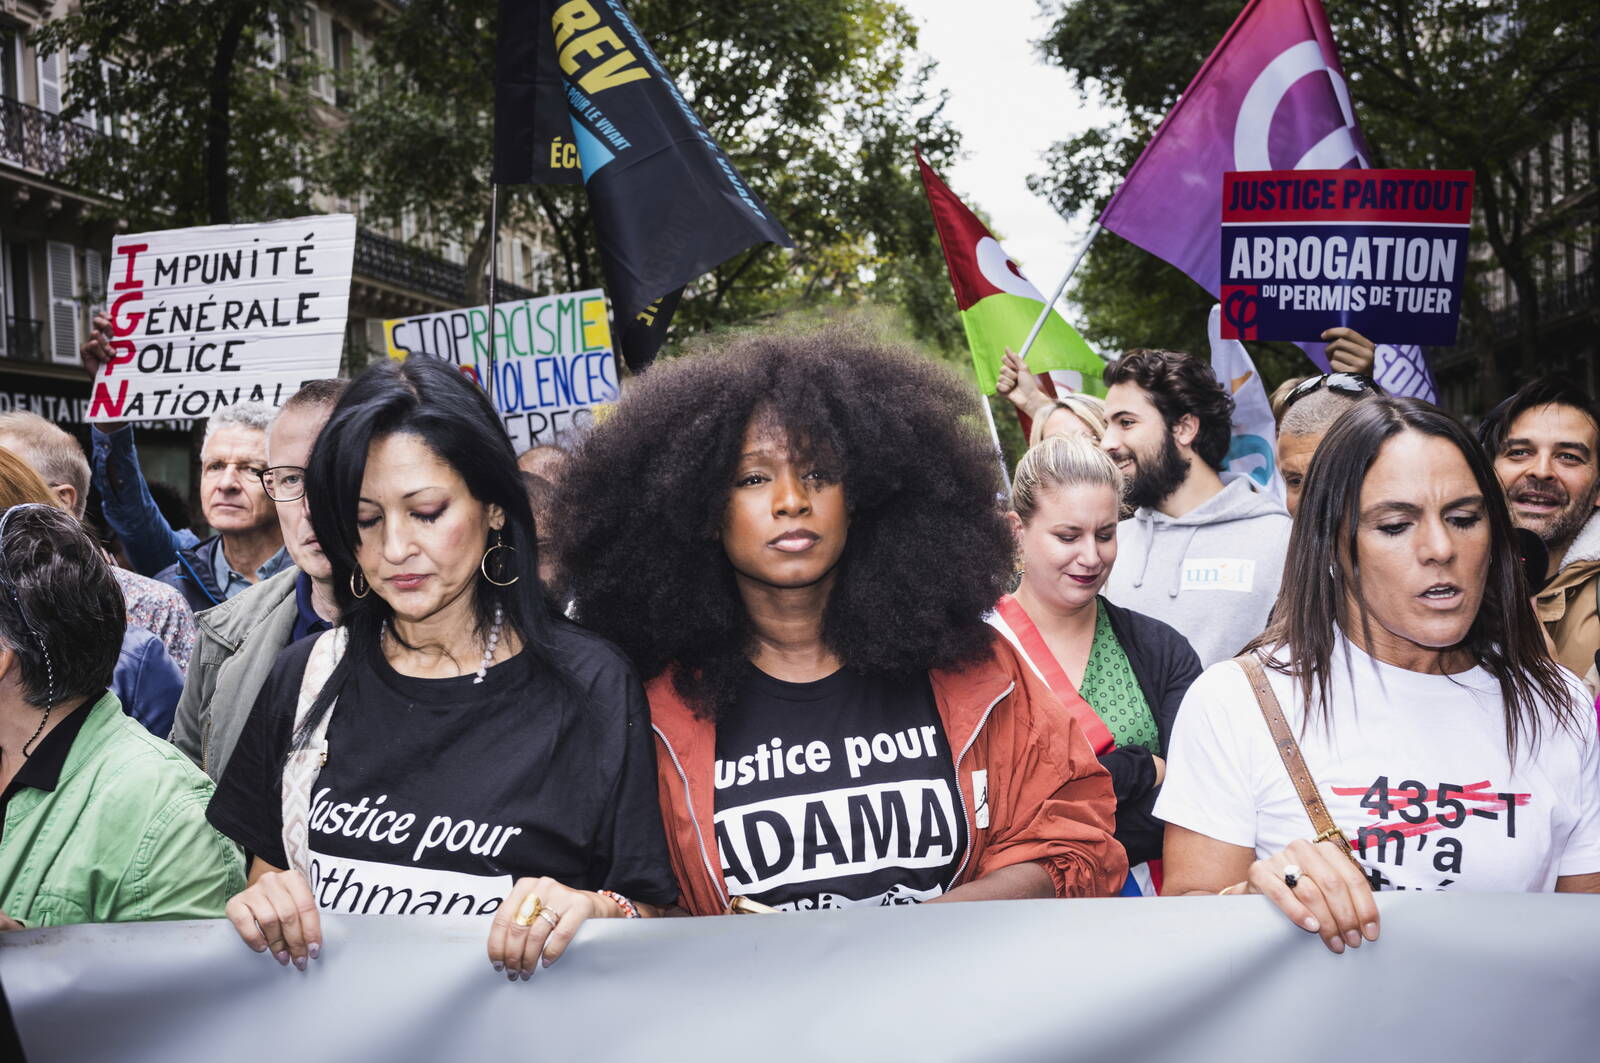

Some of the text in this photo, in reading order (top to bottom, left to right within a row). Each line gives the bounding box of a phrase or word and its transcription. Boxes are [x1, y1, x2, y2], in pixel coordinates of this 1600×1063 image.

[552, 0, 651, 94] REV
[568, 86, 632, 150] POUR LE VIVANT
[551, 136, 582, 169] ÉC
[1228, 179, 1470, 212] JUSTICE PARTOUT
[1229, 236, 1458, 282] ABROGATION
[111, 291, 321, 337] GÉNÉRALE
[1262, 285, 1453, 314] DU PERMIS DE TUER
[392, 313, 470, 366] STOP
[89, 379, 315, 418] NATIONAL
[715, 725, 938, 790] ustice pour
[1360, 776, 1516, 838] 435-1
[412, 815, 522, 862] pour
[715, 787, 954, 886] ADAMA
